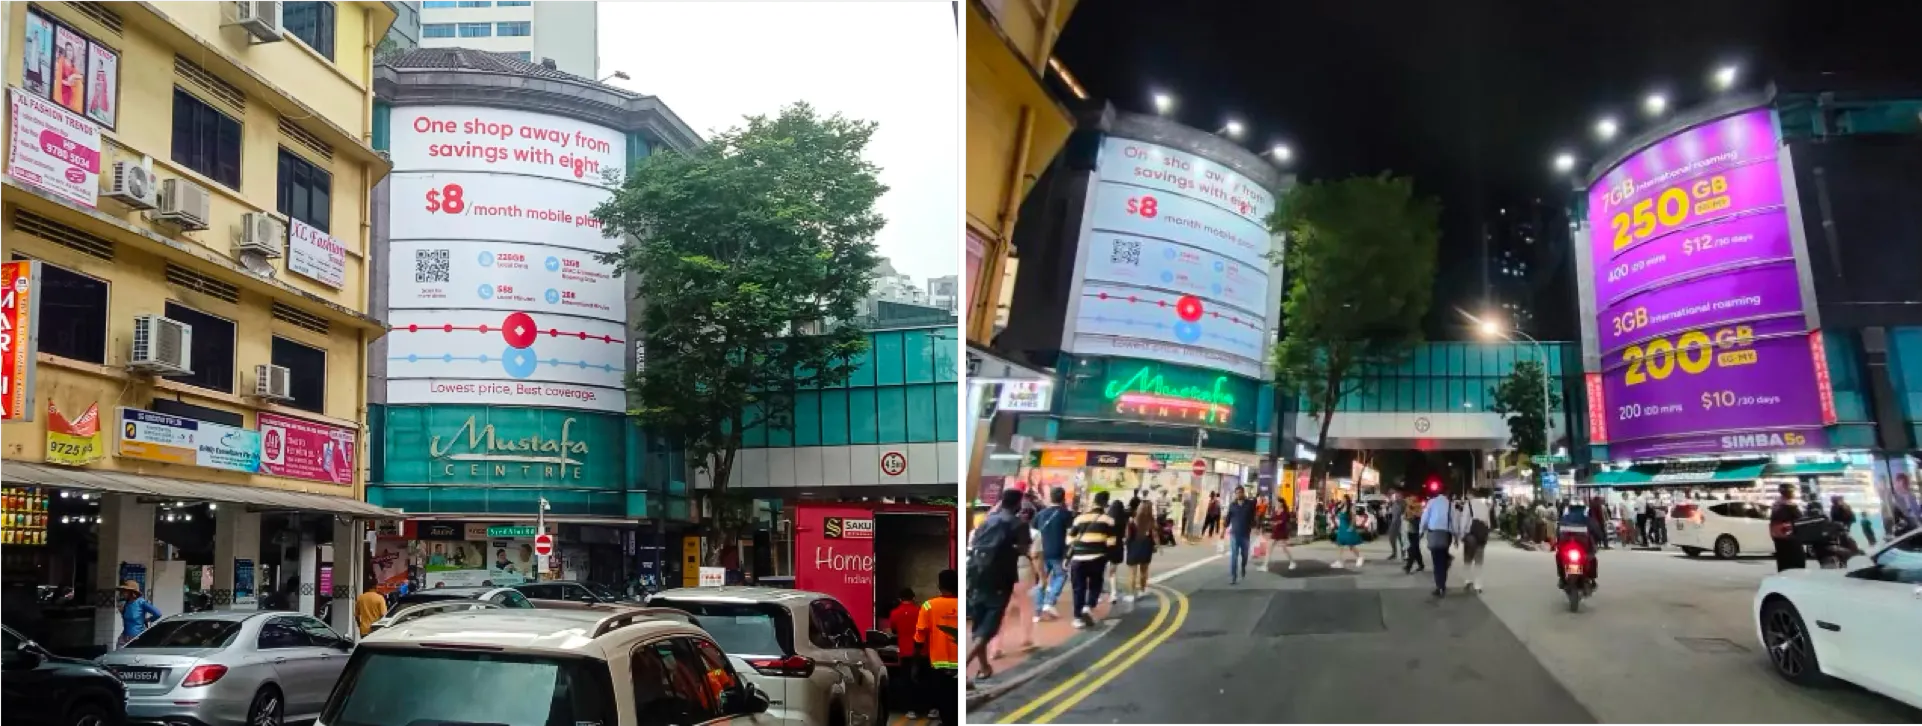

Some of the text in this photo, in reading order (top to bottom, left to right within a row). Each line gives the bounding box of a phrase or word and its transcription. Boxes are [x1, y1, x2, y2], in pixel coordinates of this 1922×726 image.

[18, 95, 27, 105] XL
[29, 99, 63, 122] FASHION
[65, 115, 93, 136] TRENDS
[413, 116, 610, 153] One shop away from
[429, 141, 508, 162] savings
[513, 147, 554, 165] with
[1134, 166, 1194, 189] savings
[1199, 182, 1227, 201] with
[1602, 178, 1635, 213] 7GB
[1693, 150, 1738, 169] roaming
[526, 208, 572, 224] mobile
[575, 214, 604, 229] plan
[1612, 175, 1728, 252] 250 GB
[310, 231, 345, 257] Fashion
[1204, 224, 1236, 243] mobile
[1683, 234, 1712, 256] $12
[1608, 263, 1629, 283] 400
[1612, 307, 1648, 337] 3GB
[1712, 295, 1761, 310] roaming
[1623, 326, 1754, 386] 200 GB
[430, 382, 597, 401] Lowest price, Best coverage.
[1105, 366, 1234, 423] Mustafa
[1701, 390, 1735, 410] $10
[1756, 396, 1780, 405] days
[1116, 404, 1228, 423] CENTRE
[1619, 404, 1641, 420] 200
[1660, 404, 1683, 414] mins
[430, 415, 588, 479] Mustafa
[1722, 433, 1784, 449] SIMBA
[445, 464, 581, 478] CENTRE
[815, 546, 872, 571] Home
